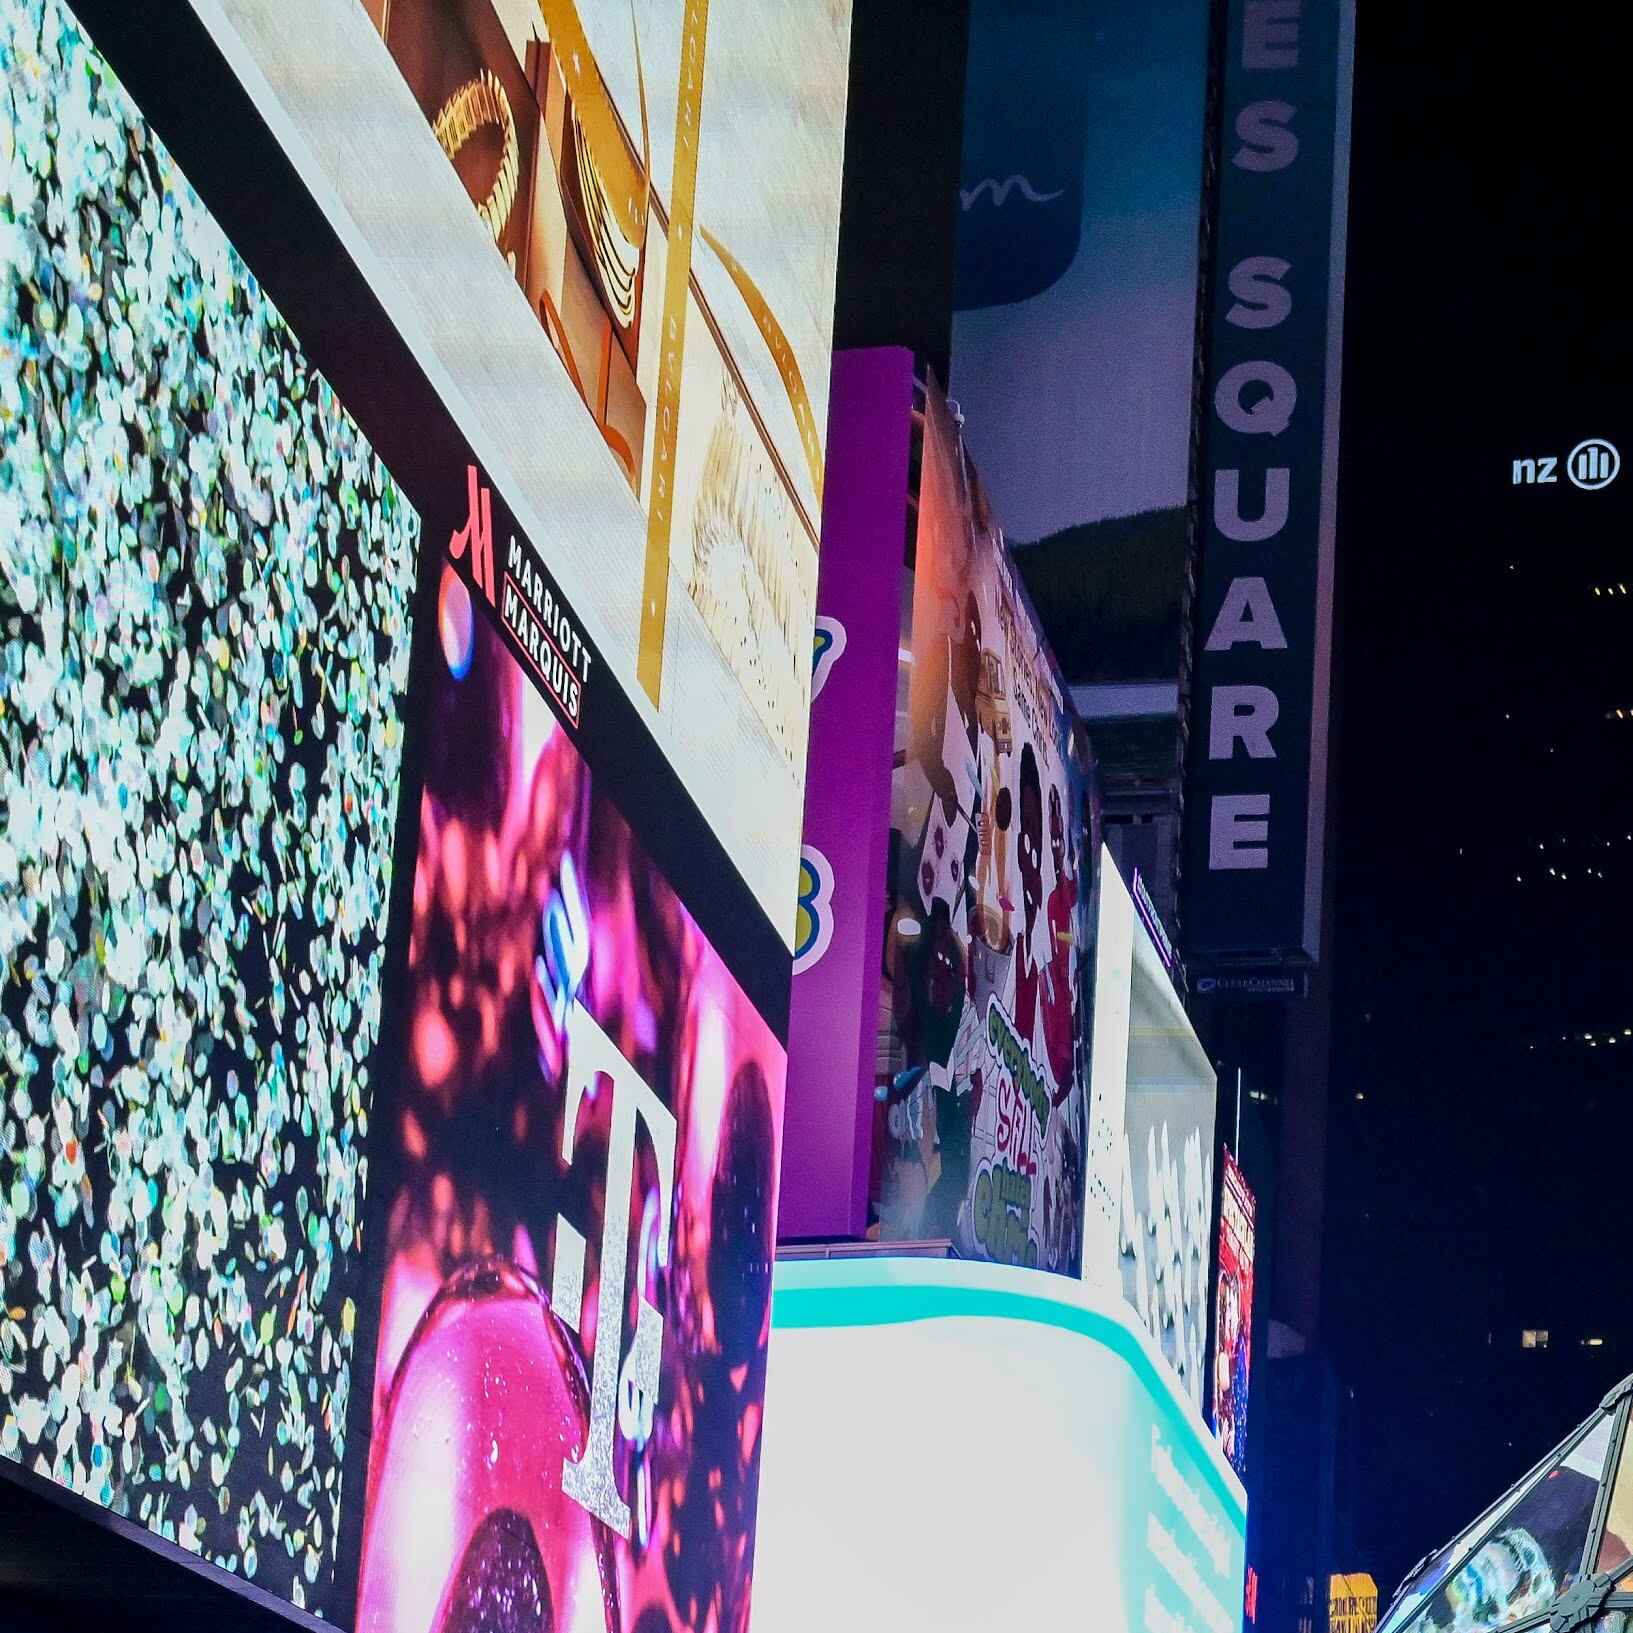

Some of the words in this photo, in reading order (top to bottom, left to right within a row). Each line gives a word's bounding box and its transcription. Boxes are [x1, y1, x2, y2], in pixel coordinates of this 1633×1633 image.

[507, 534, 592, 684] MARRIOTT
[1204, 257, 1299, 870] SQUARE
[504, 584, 580, 718] MARQUIS
